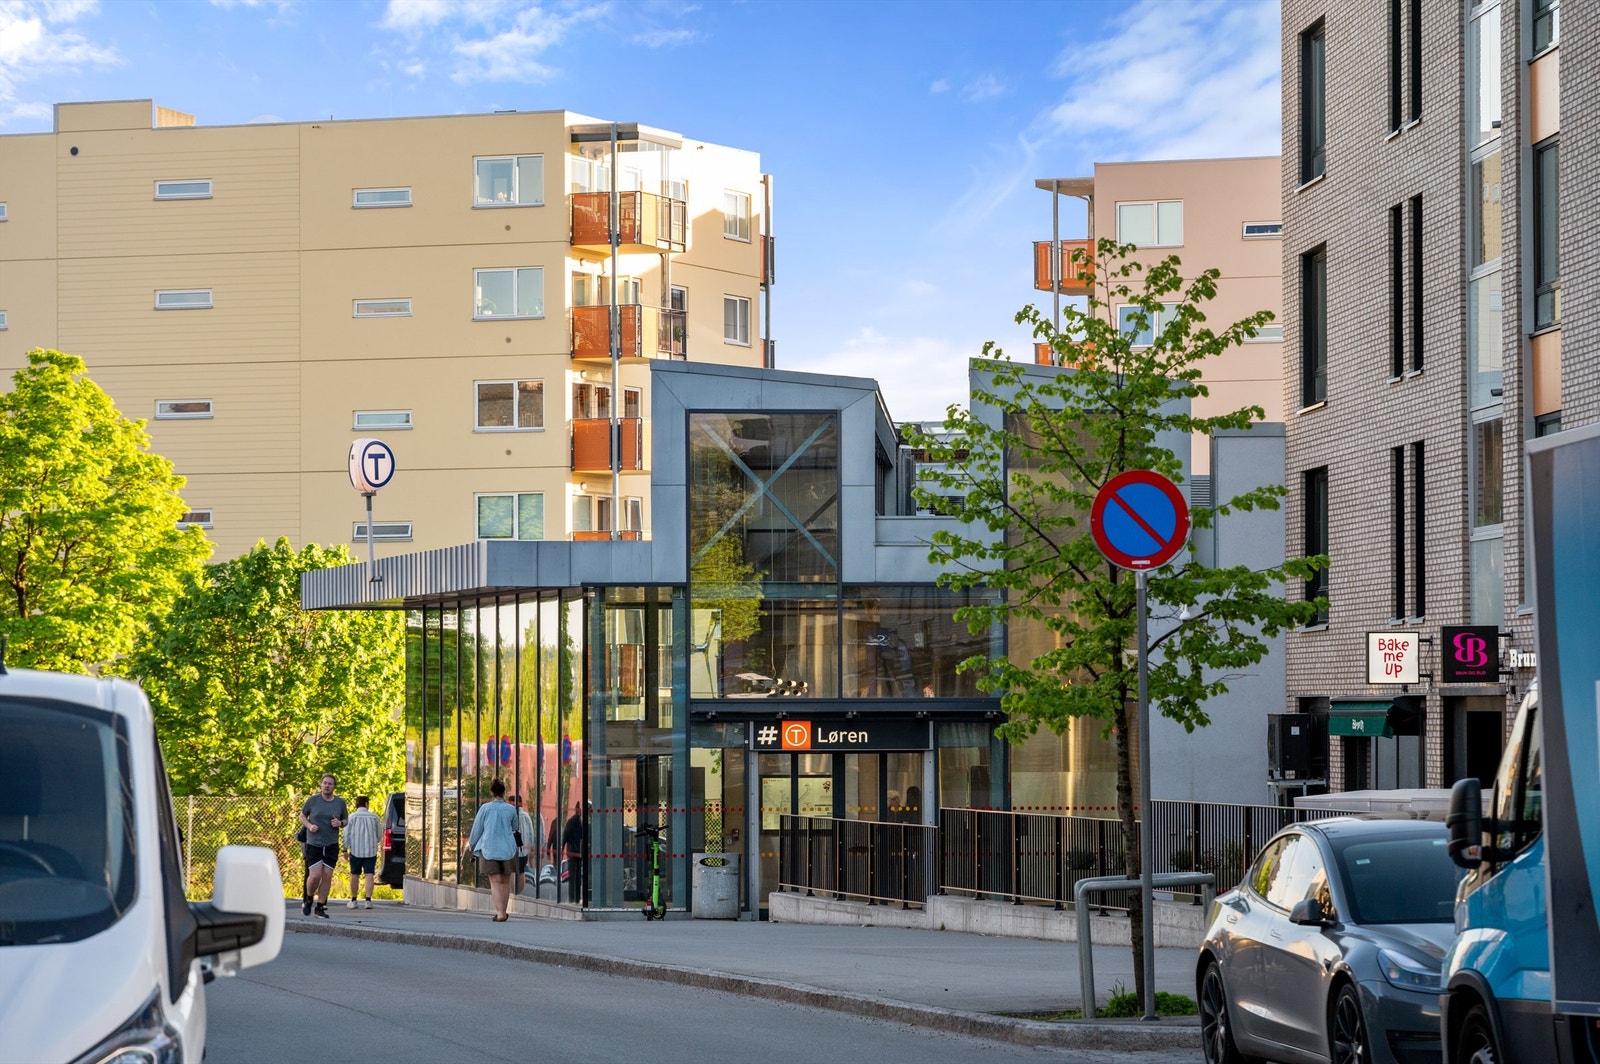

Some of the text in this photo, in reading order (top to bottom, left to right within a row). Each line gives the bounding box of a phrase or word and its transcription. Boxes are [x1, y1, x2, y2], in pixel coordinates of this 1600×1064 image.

[367, 453, 386, 480] T
[1378, 638, 1410, 651] Bake
[1384, 651, 1404, 663] me
[1509, 648, 1537, 668] Brun
[817, 727, 869, 744] Løren
